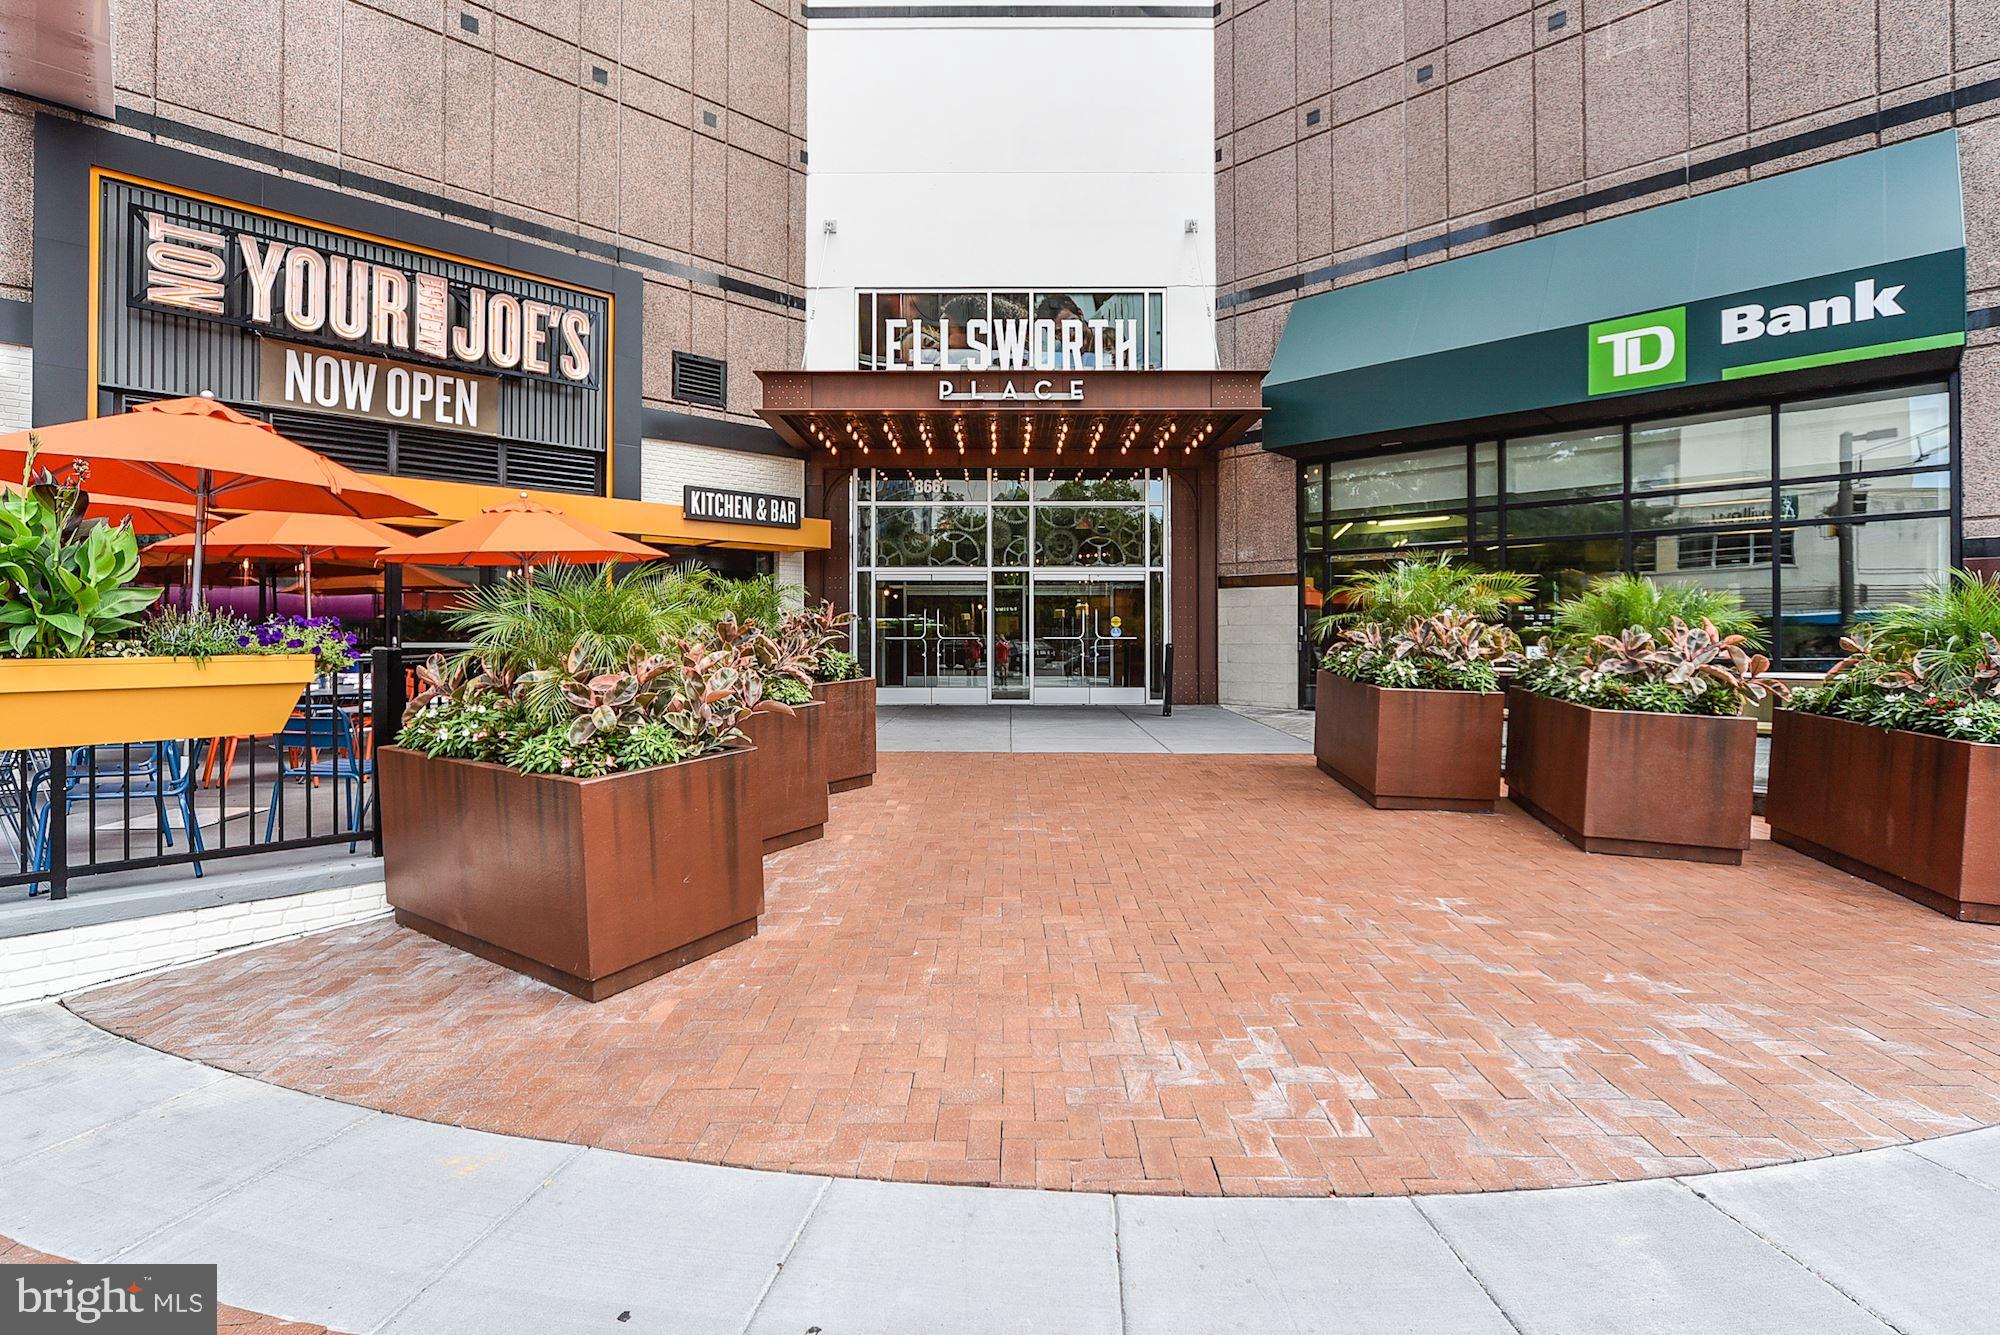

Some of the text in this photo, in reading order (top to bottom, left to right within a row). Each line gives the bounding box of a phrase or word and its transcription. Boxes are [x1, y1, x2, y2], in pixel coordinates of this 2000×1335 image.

[146, 212, 226, 315] NOT
[238, 233, 410, 350] YOUR
[452, 287, 591, 381] JOE'S
[885, 318, 1138, 371] ELLSWORTH
[1597, 278, 1907, 378] TD Bank
[285, 348, 479, 428] NOW OPEN
[938, 379, 1085, 400] PLACE
[690, 490, 796, 524] KITCHEN & BAR
[915, 479, 948, 493] 8661
